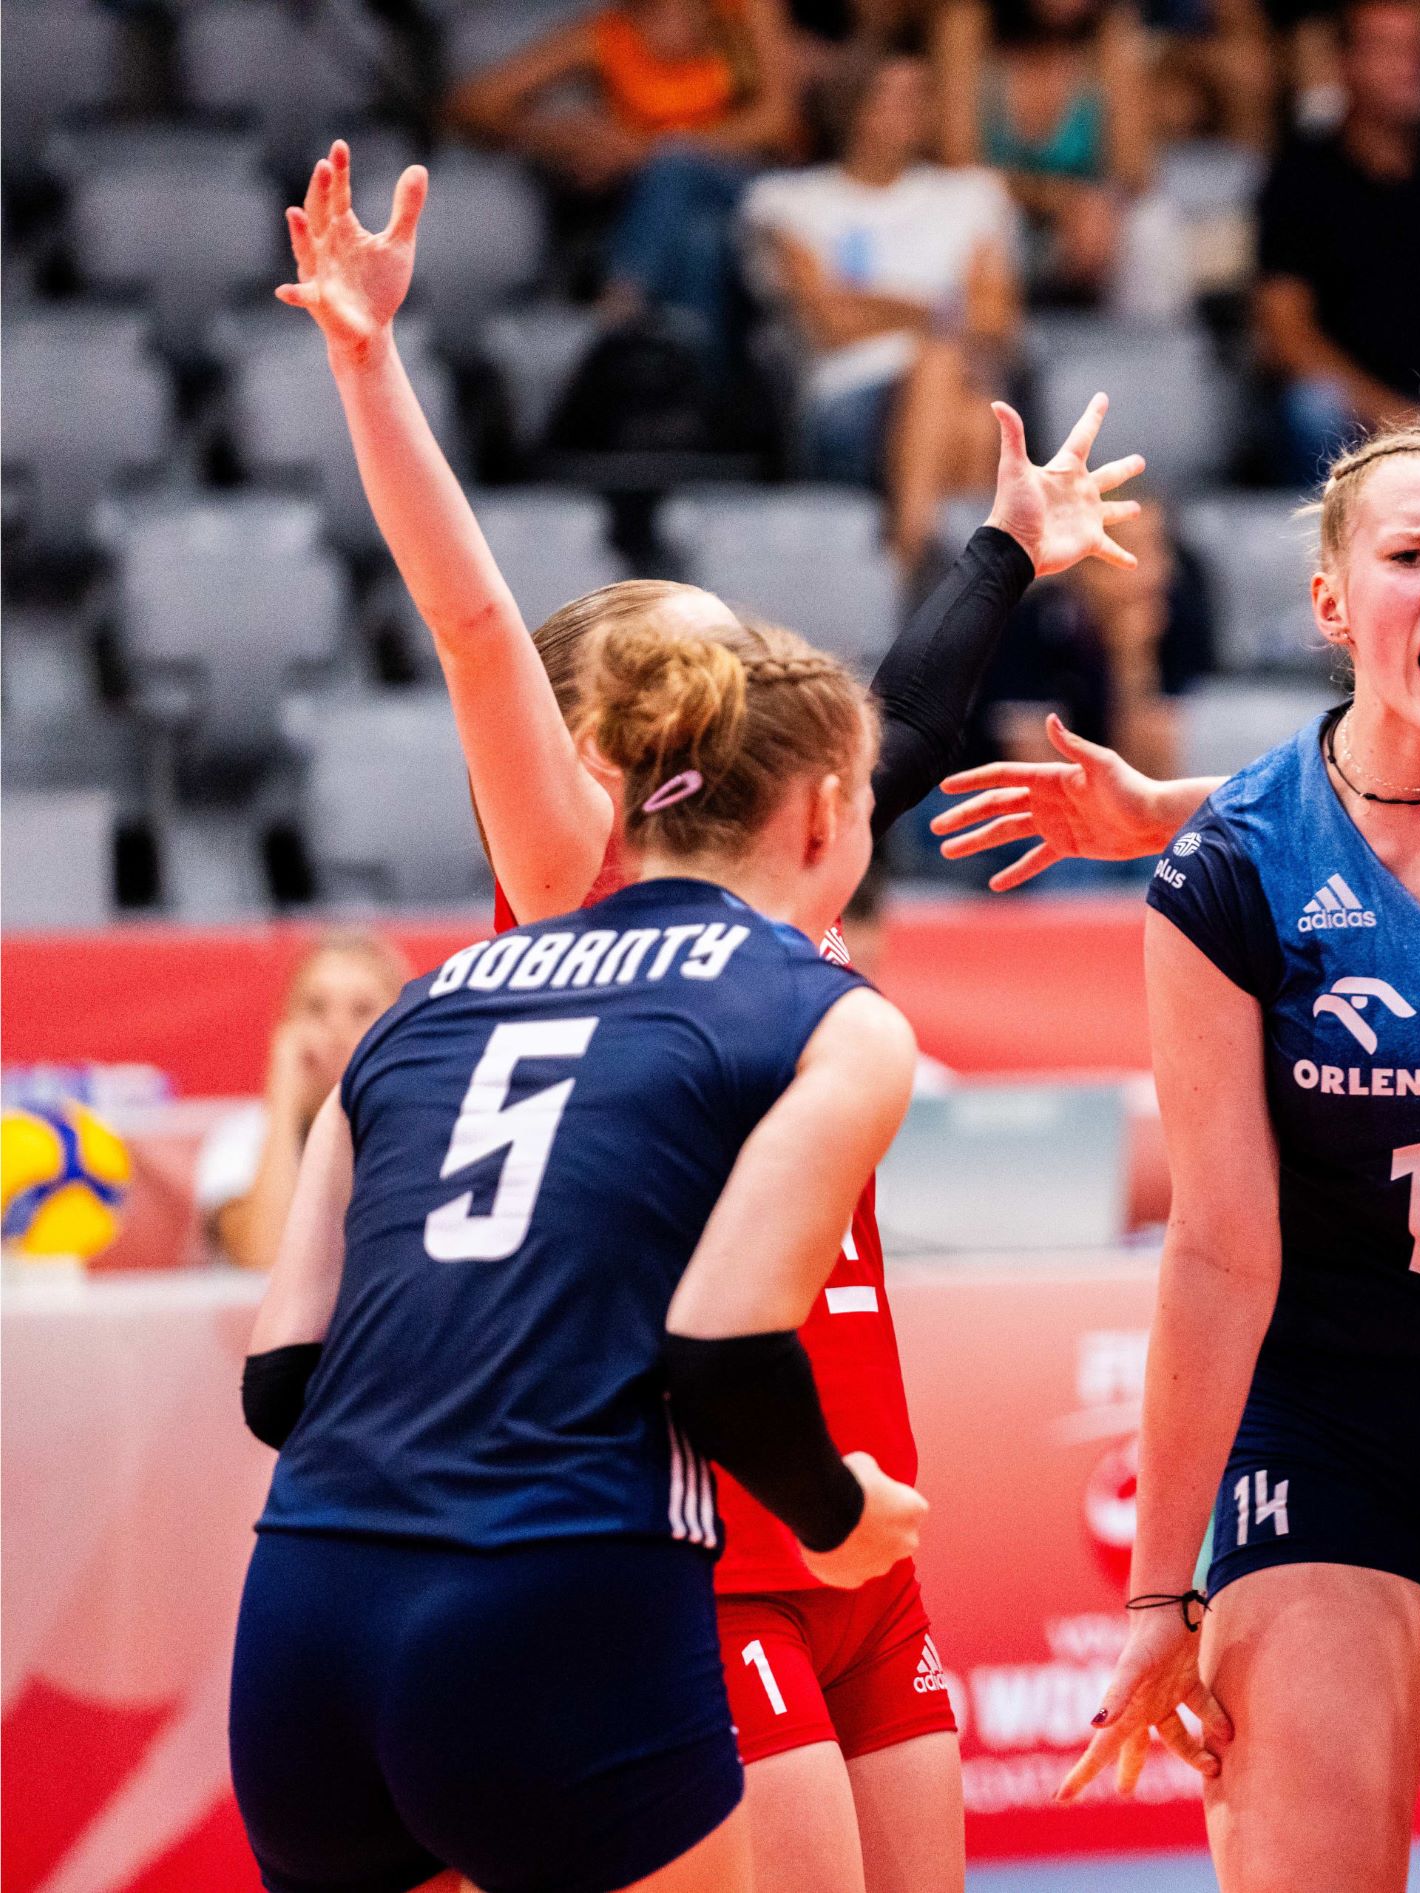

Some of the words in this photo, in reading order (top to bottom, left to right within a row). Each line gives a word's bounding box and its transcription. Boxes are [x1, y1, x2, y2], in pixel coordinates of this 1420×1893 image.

[1297, 908, 1377, 932] adidas
[429, 922, 751, 999] BOBANTY
[423, 1016, 600, 1263] 5
[1234, 1469, 1289, 1546] 14
[741, 1639, 788, 1716] 1
[913, 1671, 948, 1693] adid
